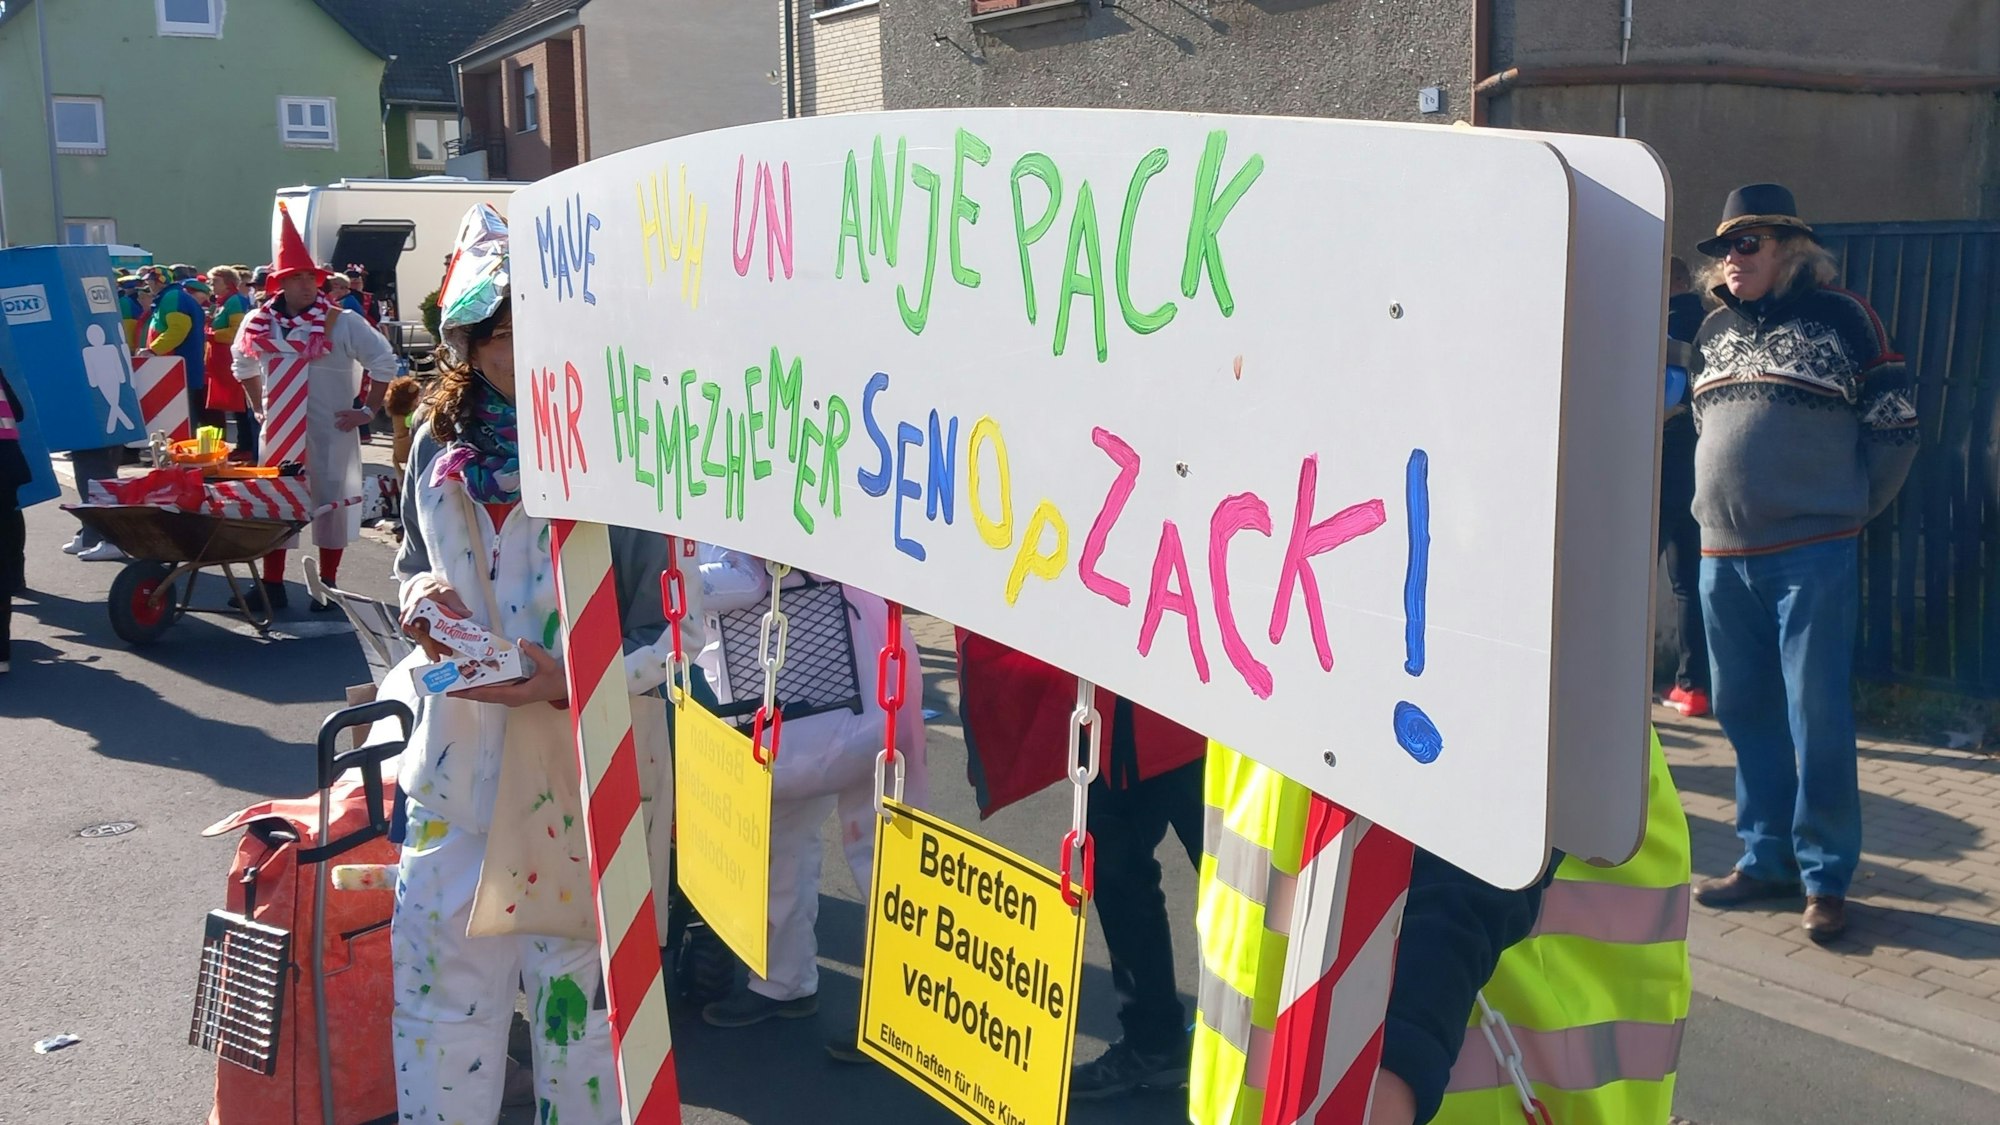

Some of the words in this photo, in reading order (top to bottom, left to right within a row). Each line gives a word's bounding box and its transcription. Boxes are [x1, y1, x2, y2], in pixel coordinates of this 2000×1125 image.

[535, 192, 601, 305] MAUE
[636, 162, 708, 310] HUH
[732, 154, 793, 282] UN
[857, 372, 958, 562] SEN
[919, 832, 1038, 931] Betreten
[883, 884, 928, 937] der
[934, 904, 1064, 1020] Baustelle
[880, 1023, 913, 1061] Eltern
[916, 1045, 951, 1084] haften
[954, 1070, 971, 1096] für
[973, 1083, 995, 1115] Ihre
[902, 962, 1032, 1073] verboten!
